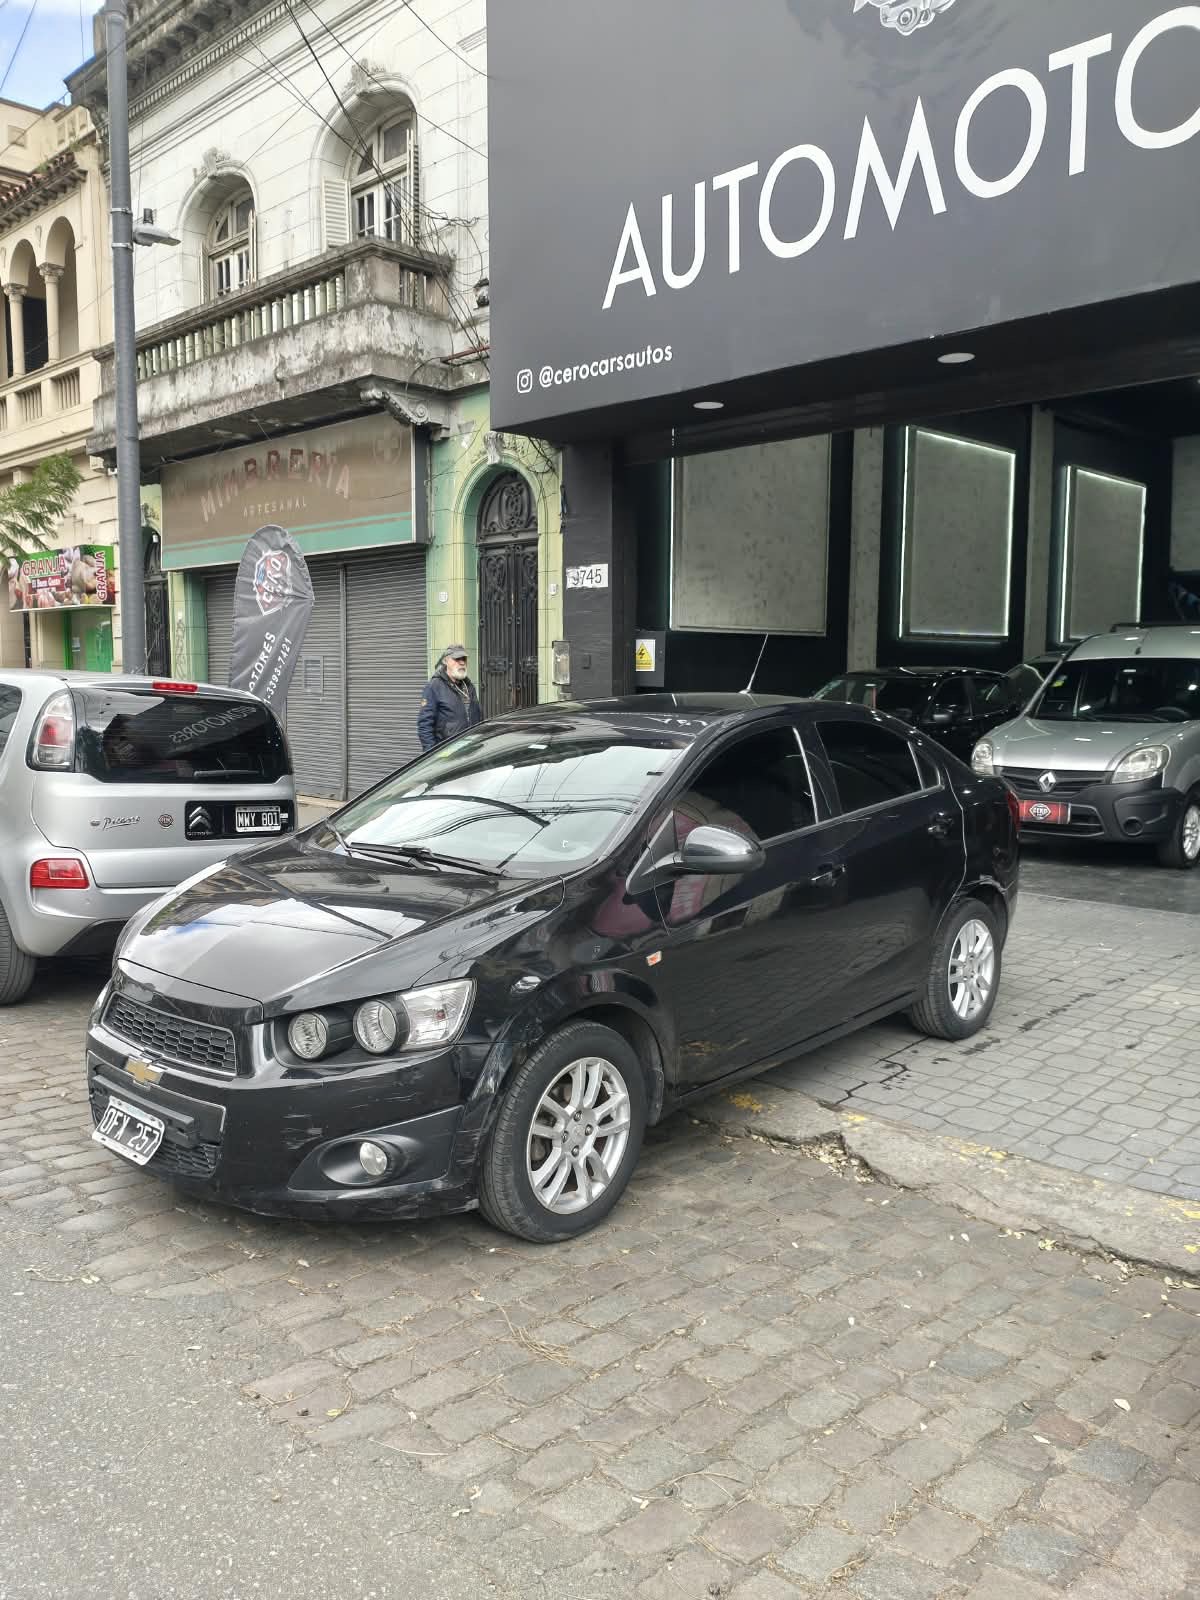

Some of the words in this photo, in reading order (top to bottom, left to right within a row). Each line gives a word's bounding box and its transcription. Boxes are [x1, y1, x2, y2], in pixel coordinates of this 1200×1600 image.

[602, 5, 1200, 310] AUTOMOTO
[539, 345, 673, 388] @cerocarsautos
[22, 554, 67, 577] GRANJA
[95, 551, 108, 601] GRANJA
[261, 811, 279, 826] 801
[127, 1123, 160, 1155] 257
